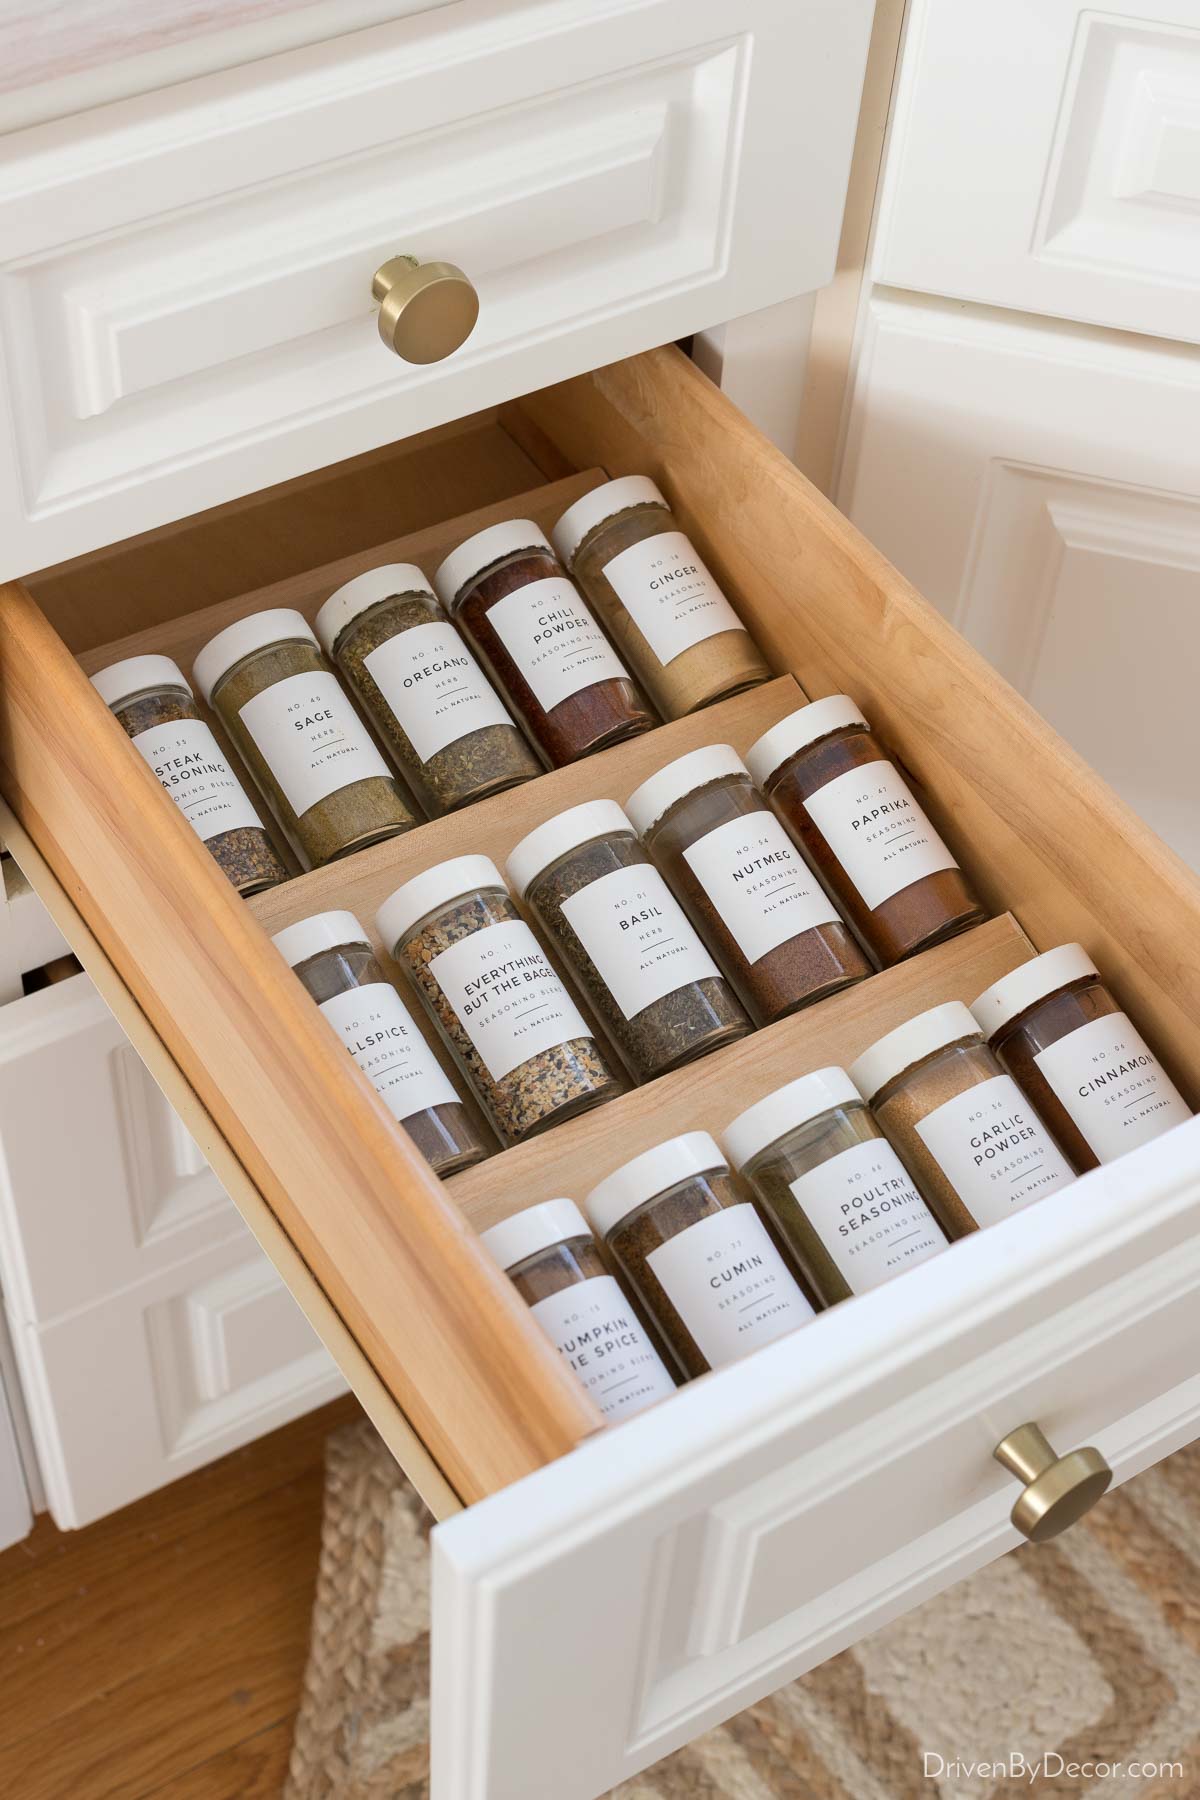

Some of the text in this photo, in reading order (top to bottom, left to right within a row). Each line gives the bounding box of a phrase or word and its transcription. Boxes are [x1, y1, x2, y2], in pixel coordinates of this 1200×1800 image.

[649, 566, 698, 590] GINGER
[658, 581, 707, 604] SEASONING
[538, 607, 574, 626] CHILI
[674, 601, 717, 621] ALL NATURAL
[533, 618, 588, 645] POWDER
[531, 636, 582, 666] SEASONING
[562, 654, 606, 673] ALL NATURAL
[403, 657, 469, 688] OREGANO
[435, 676, 458, 689] HERB
[287, 703, 306, 713] NO.
[435, 694, 481, 716] ALL NATURAL
[294, 709, 334, 731] SAGE
[310, 728, 335, 743] HERB
[154, 752, 203, 777] STEAK
[311, 746, 359, 769] ALL NATURAL
[161, 764, 225, 788] ASONING
[197, 803, 232, 817] NATURAL
[851, 799, 911, 831] PAPRIKA
[866, 816, 916, 843] SEASONING
[735, 845, 756, 856] NO.
[883, 839, 929, 862] ALL NATURAL
[732, 850, 791, 882] NUTMEG
[746, 868, 798, 895] SEASONING
[613, 899, 634, 910] NO.
[763, 890, 810, 915] ALL NATURAL
[619, 906, 663, 931] BASIL
[638, 927, 663, 942] HERB
[480, 950, 501, 961] NO.
[640, 945, 688, 971] ALL NATURAL
[464, 954, 544, 996] EVERYTHING
[463, 991, 489, 1016] BUT
[491, 976, 522, 996] THE
[478, 992, 536, 1028] SEASONING
[513, 1011, 563, 1037] ALL NATURAL
[346, 1025, 409, 1056] LLSPICE
[359, 1045, 411, 1071] EASONING
[375, 1070, 423, 1093] LL NATURAL
[1078, 1054, 1154, 1097] CINNAMON
[1104, 1075, 1157, 1106] SEASONING
[1123, 1100, 1171, 1127] ALL NATURAL
[970, 1114, 1024, 1148] GARLIC
[973, 1127, 1037, 1167] POWDER
[990, 1147, 1044, 1181] SEASONING
[840, 1177, 905, 1216] POULTRY
[1010, 1172, 1059, 1202] ALL NATURAL
[848, 1219, 908, 1256] SEASONING
[886, 1239, 936, 1267] ALL NATURAL
[710, 1255, 763, 1289] CUMIN
[717, 1274, 776, 1310] SEASONING
[738, 1303, 790, 1333] ALL NATURAL
[570, 1332, 639, 1371] IE SPICE
[617, 1385, 654, 1404] NATURAL
